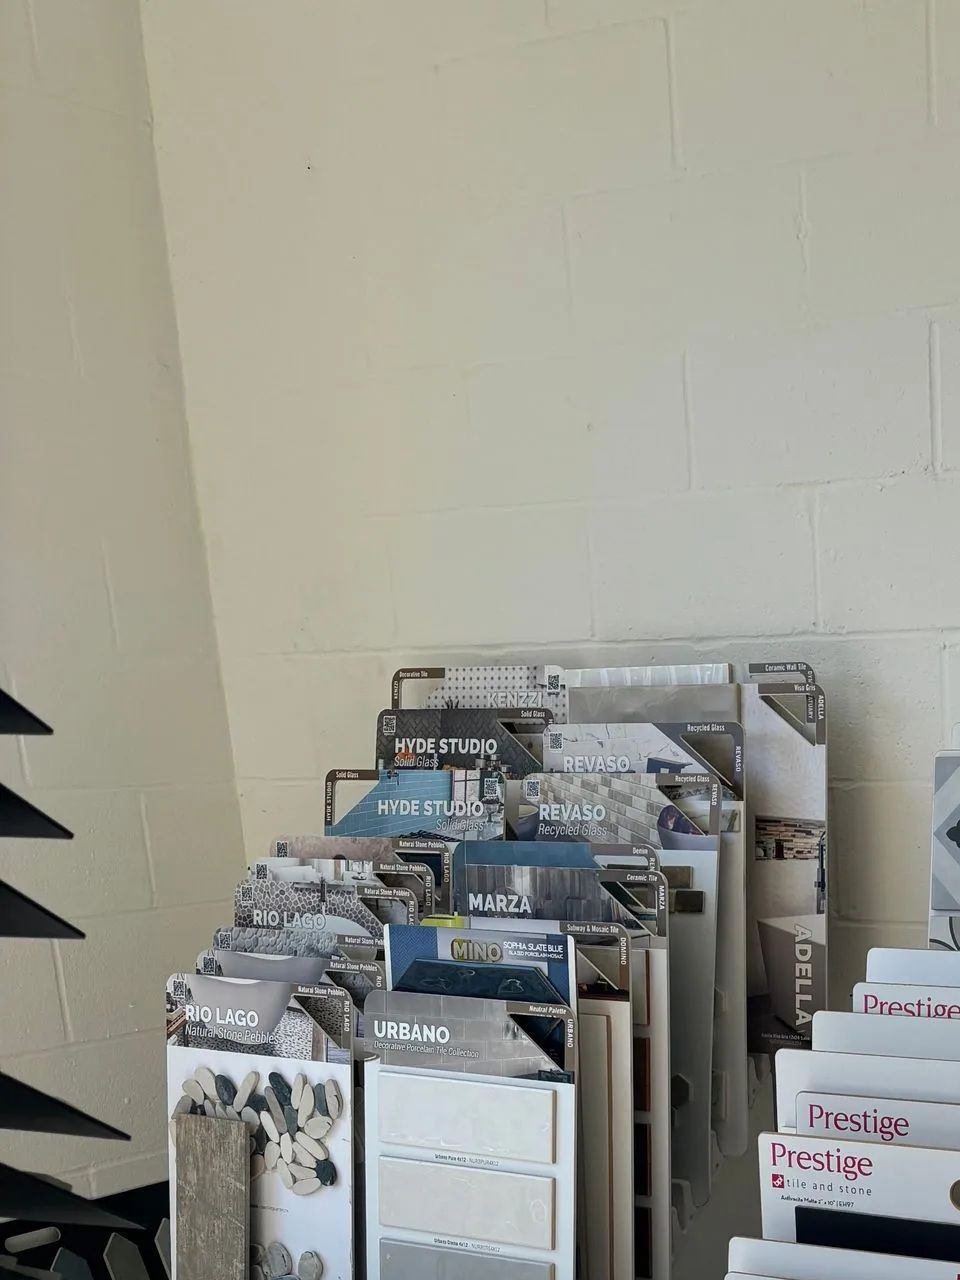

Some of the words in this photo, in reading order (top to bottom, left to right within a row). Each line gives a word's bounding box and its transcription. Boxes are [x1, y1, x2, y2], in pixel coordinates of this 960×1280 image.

[487, 690, 544, 709] KENZZI
[687, 724, 710, 733] Recycled
[711, 724, 725, 732] Glass
[394, 738, 436, 755] HYDE
[438, 737, 498, 756] STUDIO
[393, 754, 415, 768] Solid
[416, 755, 439, 768] Glass
[563, 756, 631, 773] REVASO
[675, 775, 696, 783] Recycled
[697, 775, 710, 783] Glass
[377, 799, 420, 816] HYDE
[423, 799, 484, 816] STUDIO
[539, 803, 606, 822] REVASO
[435, 819, 457, 832] Solid
[457, 819, 484, 832] Glass
[537, 822, 580, 837] Recycled
[581, 823, 608, 838] Glass
[626, 873, 648, 882] Ceramic
[468, 893, 533, 914] MARZA
[658, 885, 666, 910] MARZA
[253, 910, 280, 926] RIO
[283, 911, 327, 931] LAGO
[451, 938, 504, 963] MINO
[503, 940, 528, 951] SOPHIA
[528, 943, 547, 953] SLATE
[793, 923, 813, 1027] ADELLA
[185, 1005, 212, 1023] RIO
[216, 1008, 259, 1028] LAGO
[529, 1004, 548, 1014] Neutral
[548, 1007, 567, 1015] Palette
[185, 1024, 216, 1039] Natural
[216, 1028, 244, 1042] Stone
[244, 1031, 280, 1046] Pebbles
[373, 1020, 450, 1045] URBANO
[374, 1040, 406, 1052] Decorative
[406, 1043, 435, 1055] Porcelain
[436, 1046, 447, 1056] Tile
[448, 1047, 480, 1059] Collection
[808, 1103, 910, 1142] Prestige
[771, 1142, 874, 1182] Prestige
[786, 1178, 807, 1190] tile
[812, 1182, 834, 1193] and
[838, 1185, 873, 1197] stone
